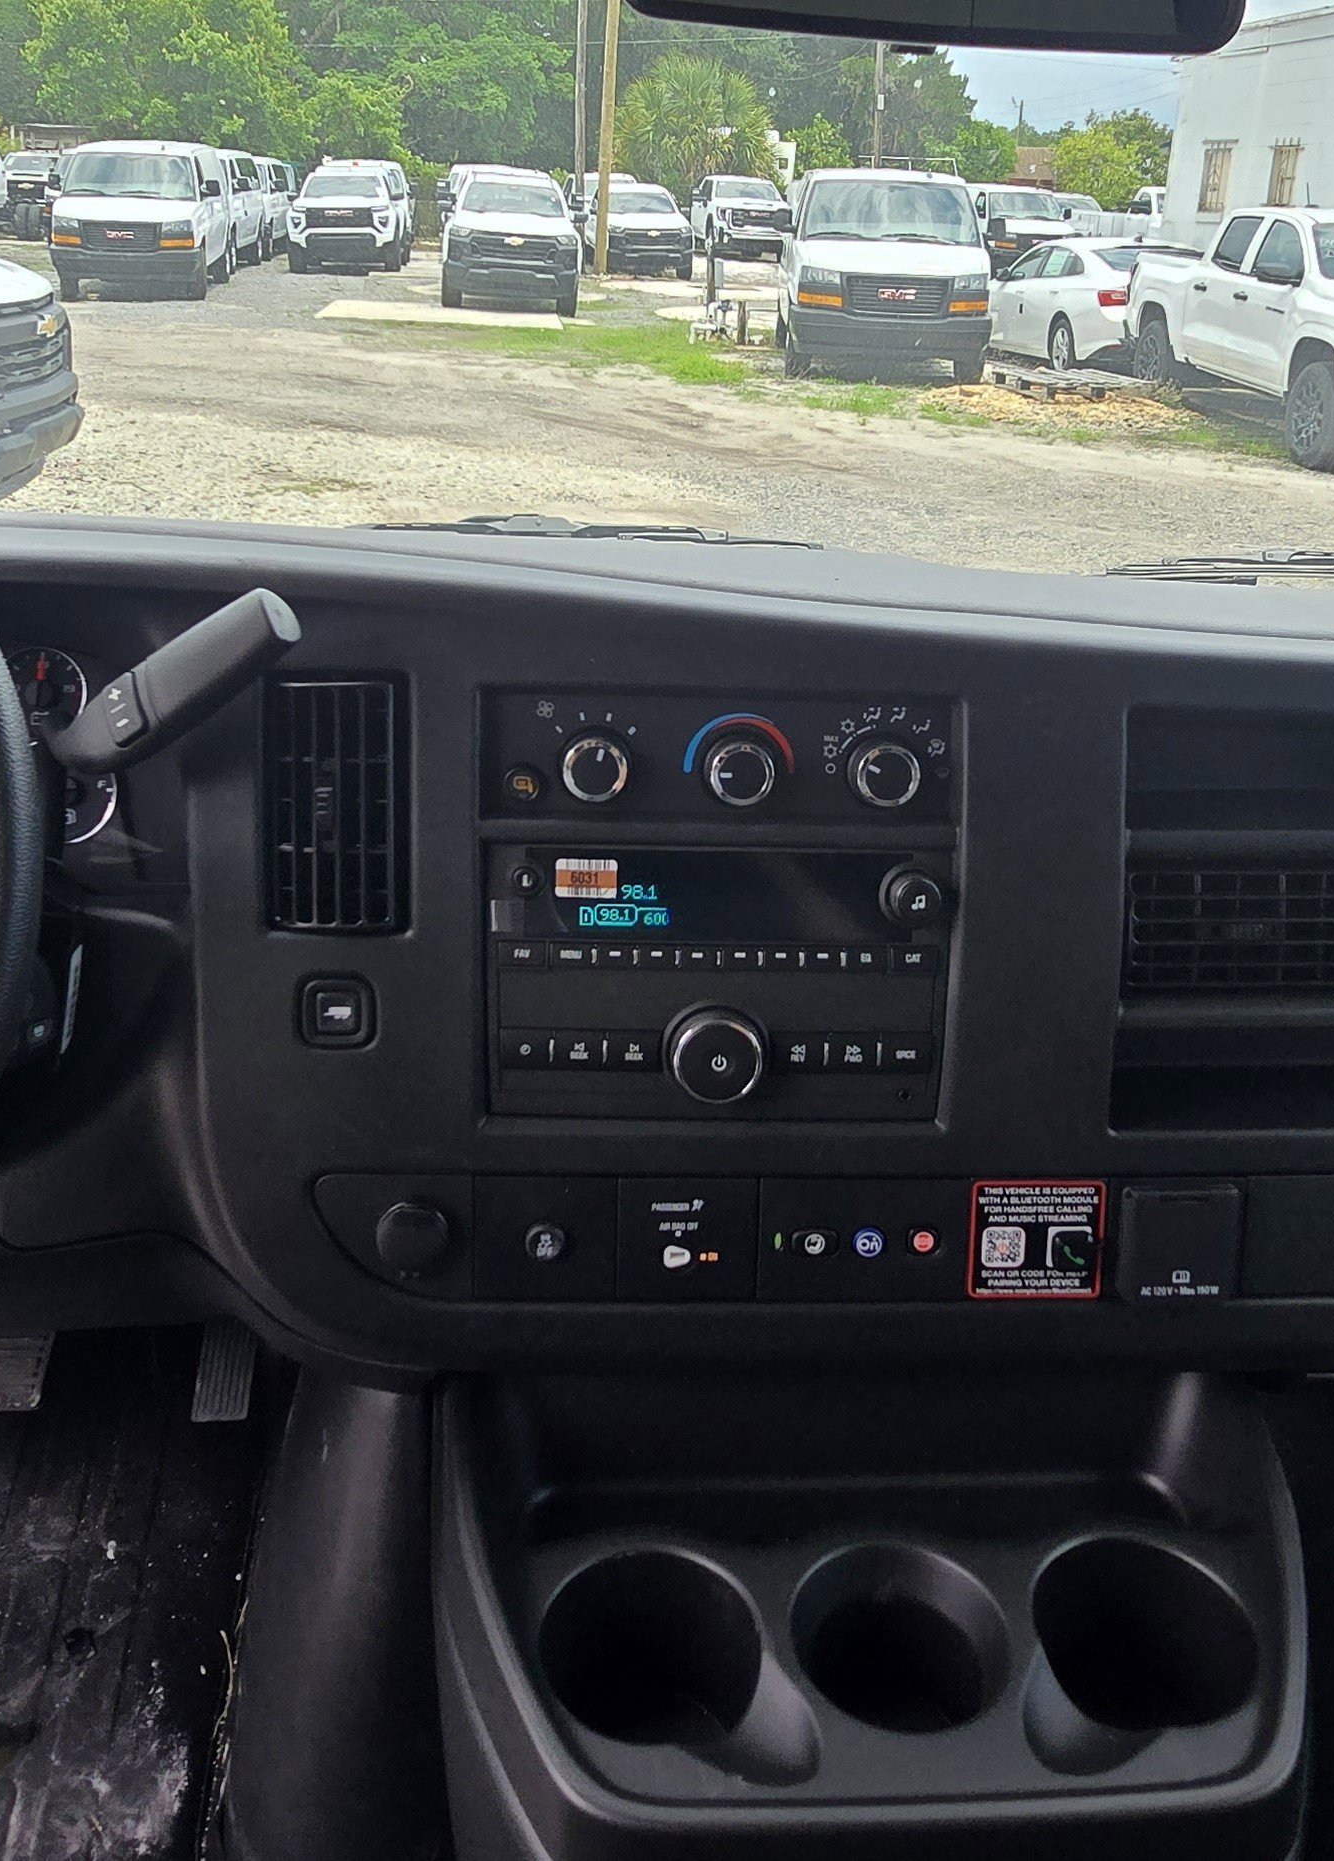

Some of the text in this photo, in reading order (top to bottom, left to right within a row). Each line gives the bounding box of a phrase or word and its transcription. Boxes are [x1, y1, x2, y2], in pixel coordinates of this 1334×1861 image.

[104, 229, 135, 240] GMC
[877, 288, 917, 300] GMC
[96, 779, 107, 789] F
[570, 871, 599, 885] 6031
[620, 884, 658, 900] 98.1
[599, 908, 631, 921] 98.1
[513, 948, 531, 959] FAV
[559, 949, 583, 960] MENU
[905, 953, 922, 963] CAT
[569, 1050, 589, 1060] SEEK
[624, 1052, 644, 1061] SEEK
[844, 1054, 863, 1063] FWD
[895, 1050, 917, 1060] SRCE
[983, 1187, 1096, 1195] THIS VEHICLE IS EQUIPPED
[978, 1196, 1002, 1204] WITH
[1009, 1196, 1062, 1204] BLUETOOTH
[1062, 1196, 1099, 1204] MODULE
[984, 1205, 1094, 1213] FOR HANDSFREE CALLING
[988, 1215, 1088, 1223] AND MUSIC STREAMING
[981, 1270, 1006, 1278] SCAN
[1006, 1270, 1020, 1278] QR
[1020, 1270, 1045, 1278] CODE
[987, 1279, 1081, 1287] PAIRING YOUR DEVICE
[1140, 1286, 1152, 1296] AC
